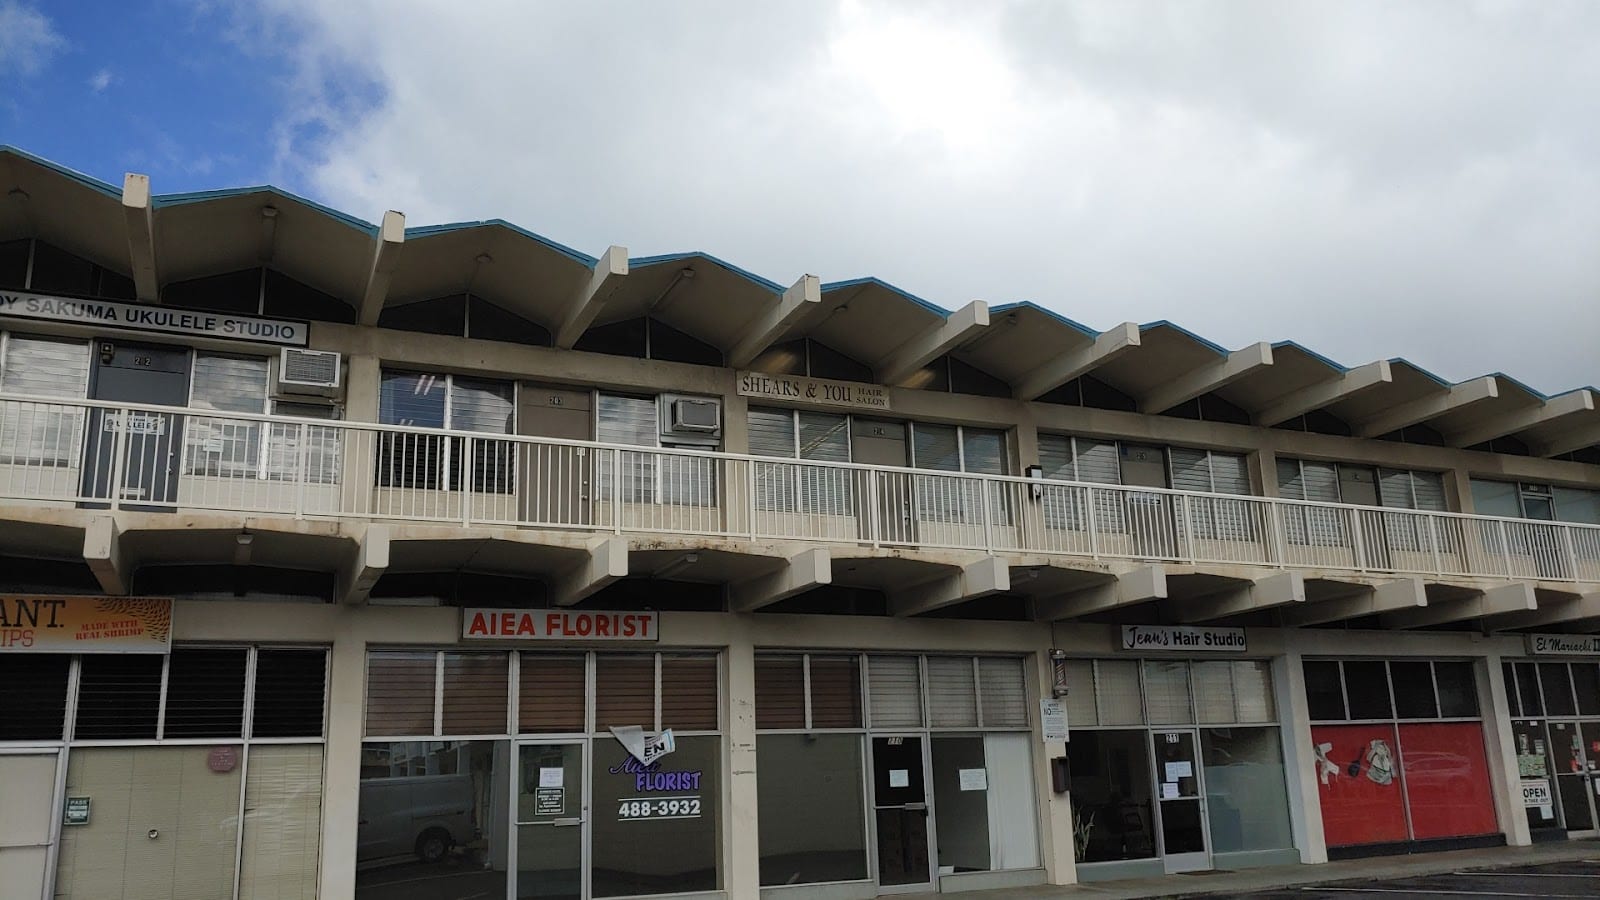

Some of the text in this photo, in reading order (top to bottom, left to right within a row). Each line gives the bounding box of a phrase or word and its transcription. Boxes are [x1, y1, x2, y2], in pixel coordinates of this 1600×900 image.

[26, 298, 117, 320] SAKUMA
[126, 309, 216, 331] UKULELE
[223, 320, 294, 339] STUDIO
[742, 376, 882, 402] SHEARS & YOU HAIR
[856, 398, 885, 407] SALON
[81, 619, 138, 631] MADE WITH
[469, 612, 652, 637] AIEA FLORIST
[75, 628, 144, 640] REAL SHRIMP
[1126, 626, 1245, 648] Jean's Hair Studio
[1536, 637, 1547, 651] El
[1549, 638, 1592, 651] Mariachi
[636, 770, 702, 792] FLORIST
[1523, 788, 1547, 798] OPEN
[618, 800, 701, 817] 488-3932
